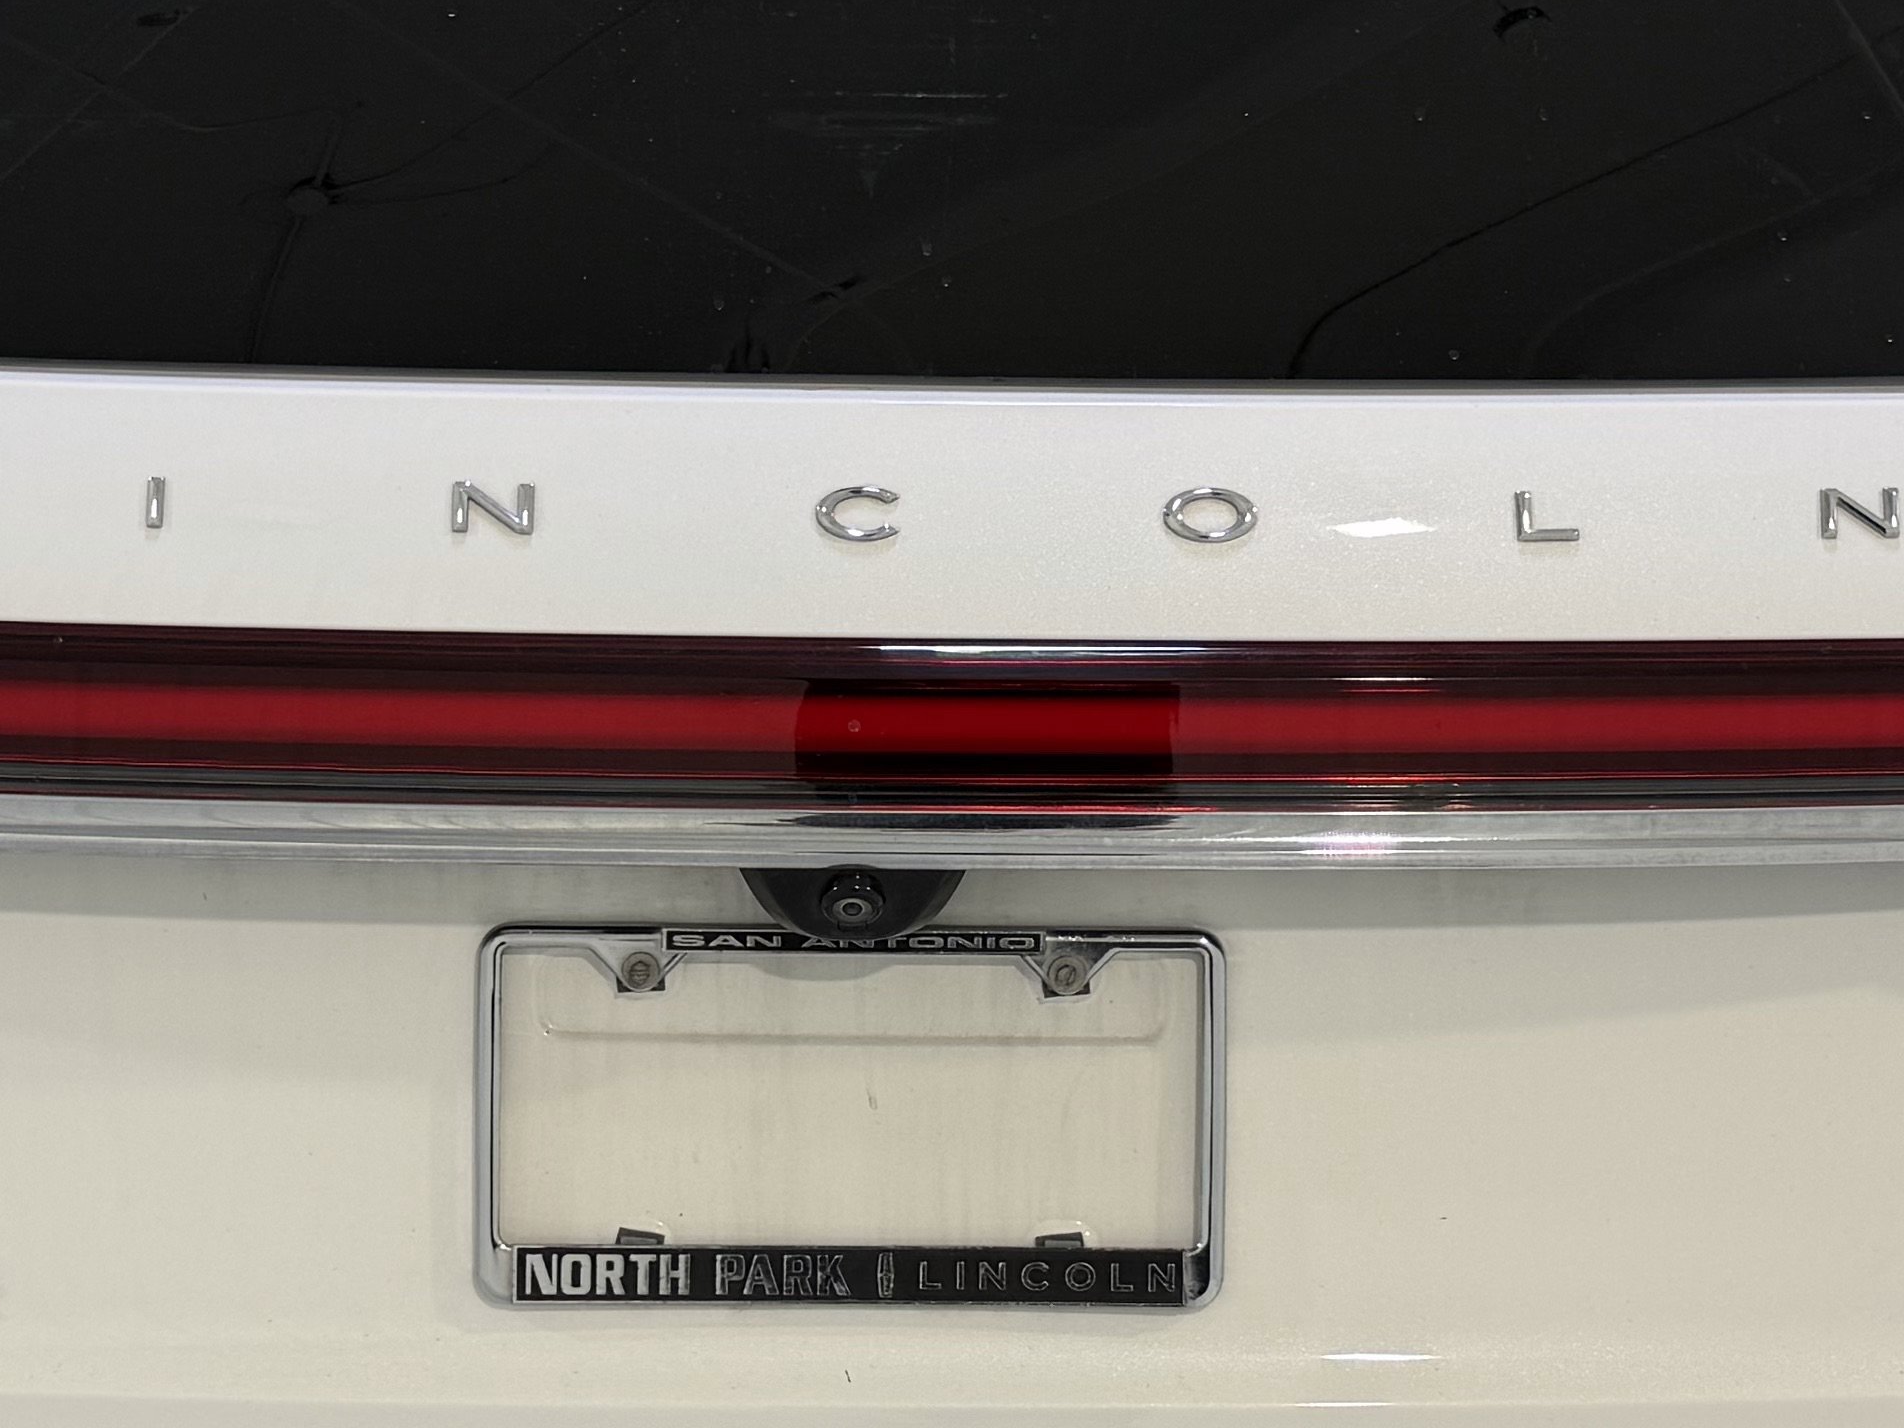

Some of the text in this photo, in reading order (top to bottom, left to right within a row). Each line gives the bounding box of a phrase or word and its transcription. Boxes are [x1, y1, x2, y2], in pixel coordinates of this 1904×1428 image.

[672, 934, 1035, 949] SAN ANTONIO
[525, 1253, 1176, 1296] NORTH PARK LINCOLN
